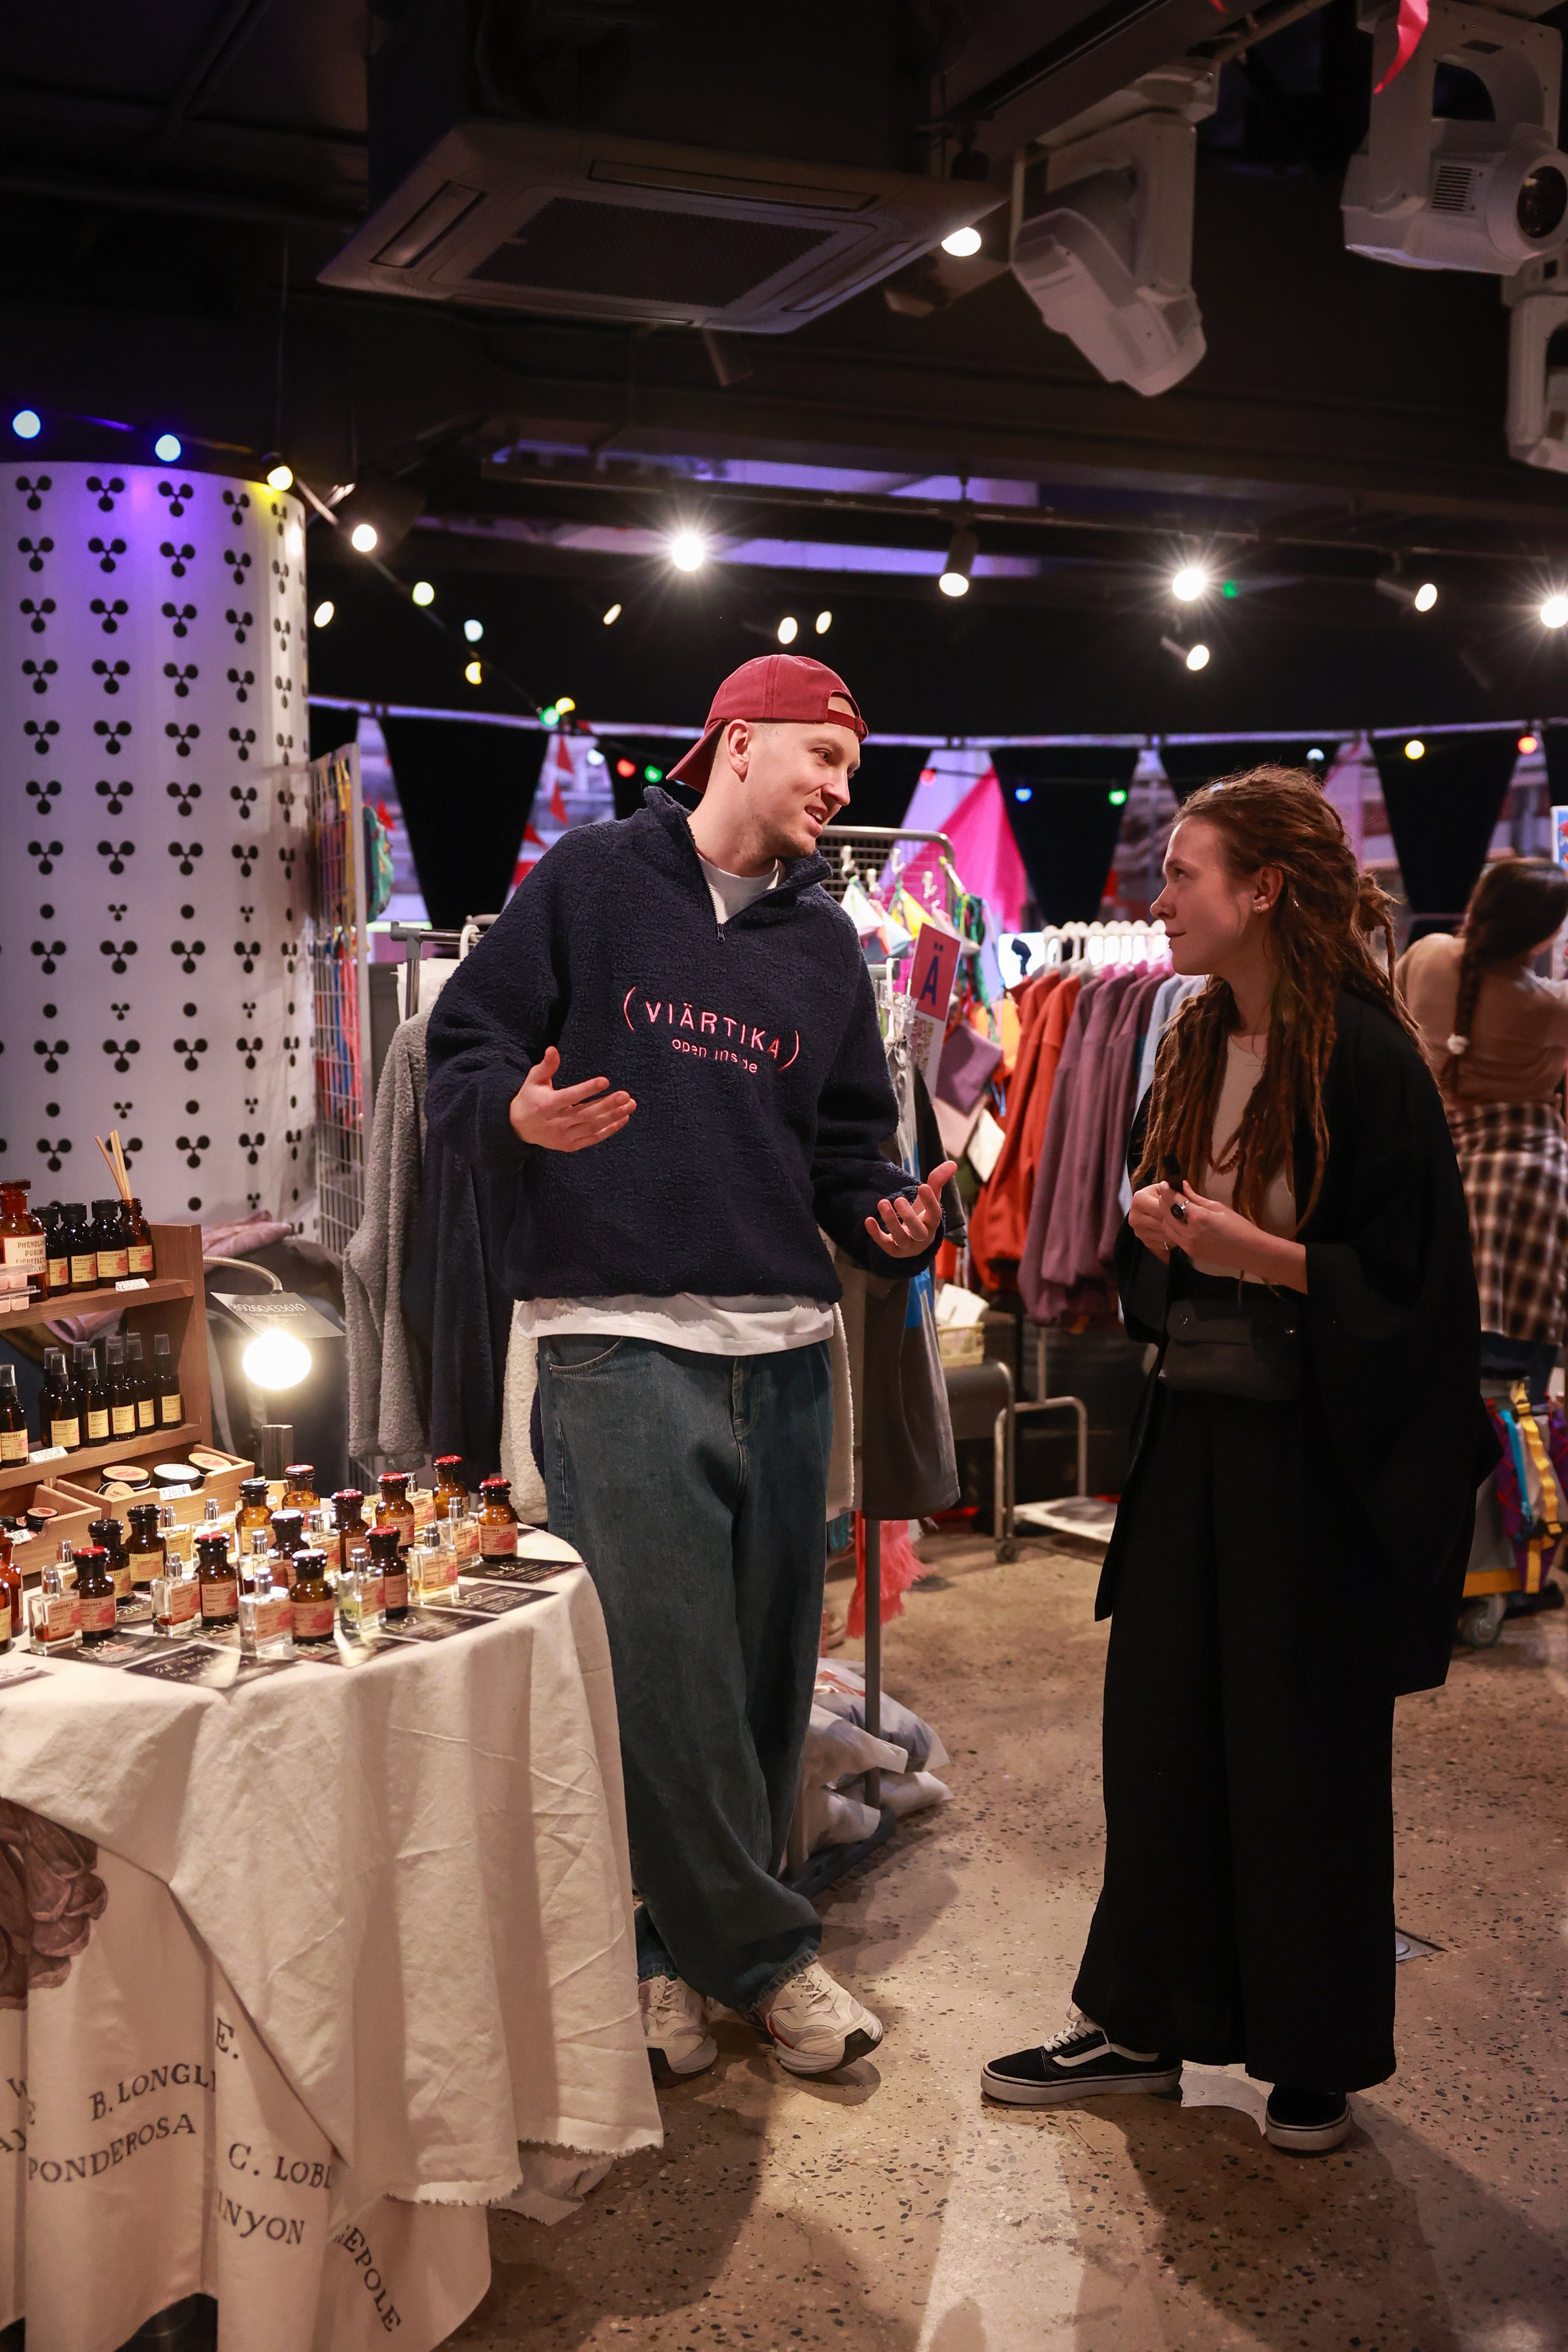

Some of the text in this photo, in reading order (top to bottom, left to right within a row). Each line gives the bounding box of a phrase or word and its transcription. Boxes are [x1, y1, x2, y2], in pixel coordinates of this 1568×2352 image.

[672, 1039, 758, 1073] open insde
[89, 2091, 113, 2121] B.
[28, 2114, 195, 2182] PONDEROSA
[228, 2143, 260, 2176] C.
